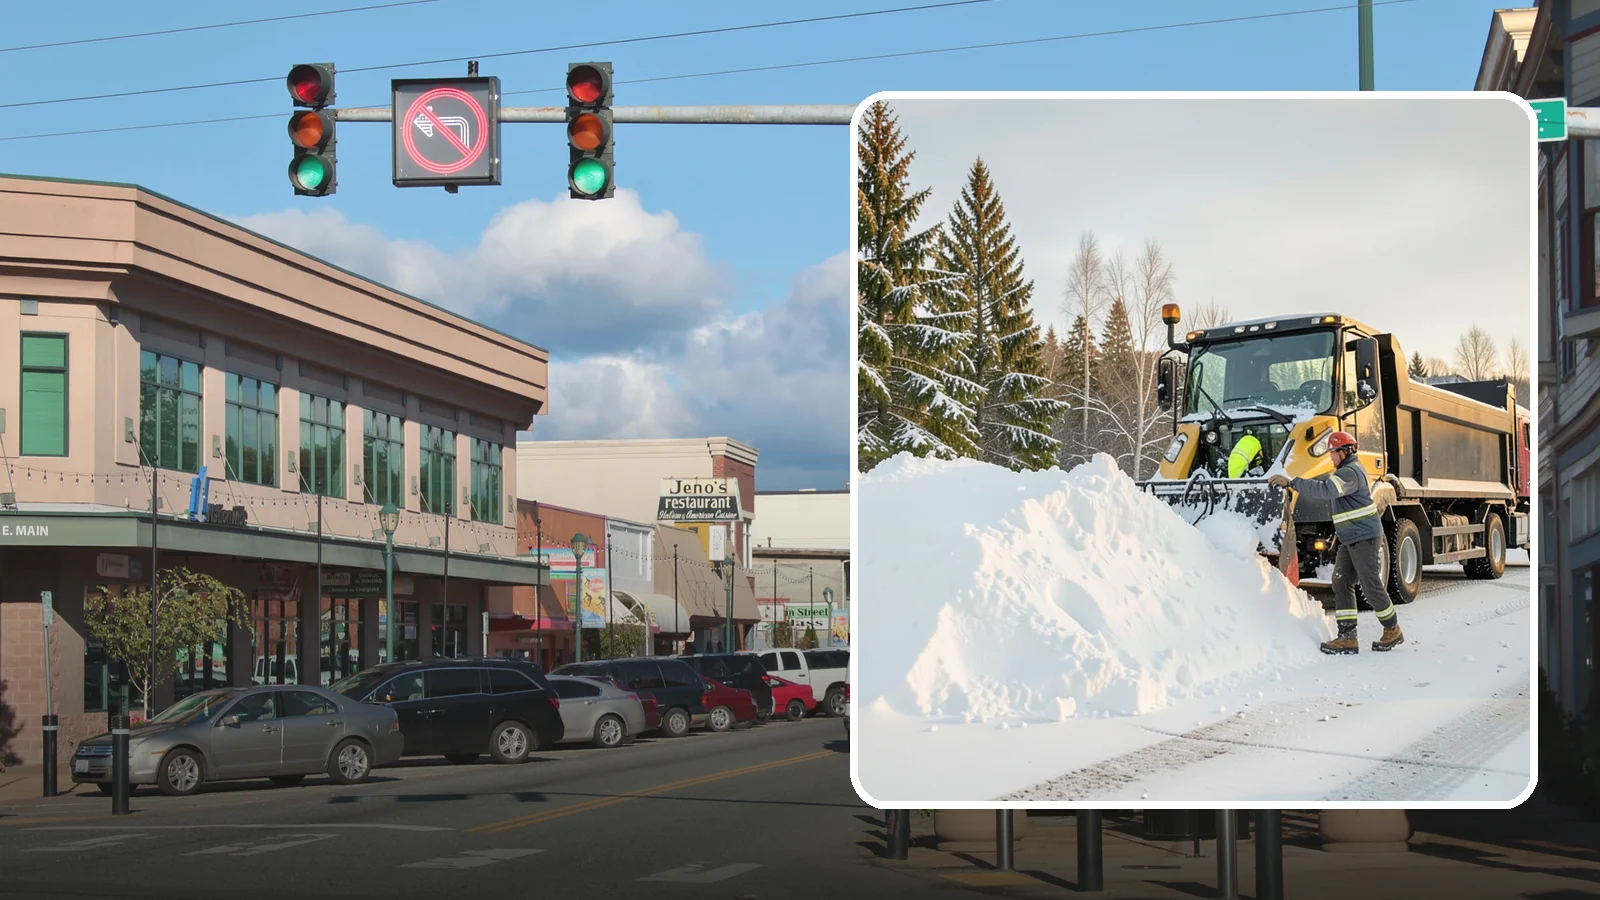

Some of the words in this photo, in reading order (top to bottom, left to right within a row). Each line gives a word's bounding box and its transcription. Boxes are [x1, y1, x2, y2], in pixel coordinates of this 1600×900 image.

[670, 480, 727, 494] Jeno's
[665, 496, 731, 508] restaurant
[686, 509, 714, 519] American
[715, 509, 737, 519] Cuisine
[2, 525, 13, 536] E.
[15, 525, 49, 536] MAIN
[797, 607, 829, 617] Street
